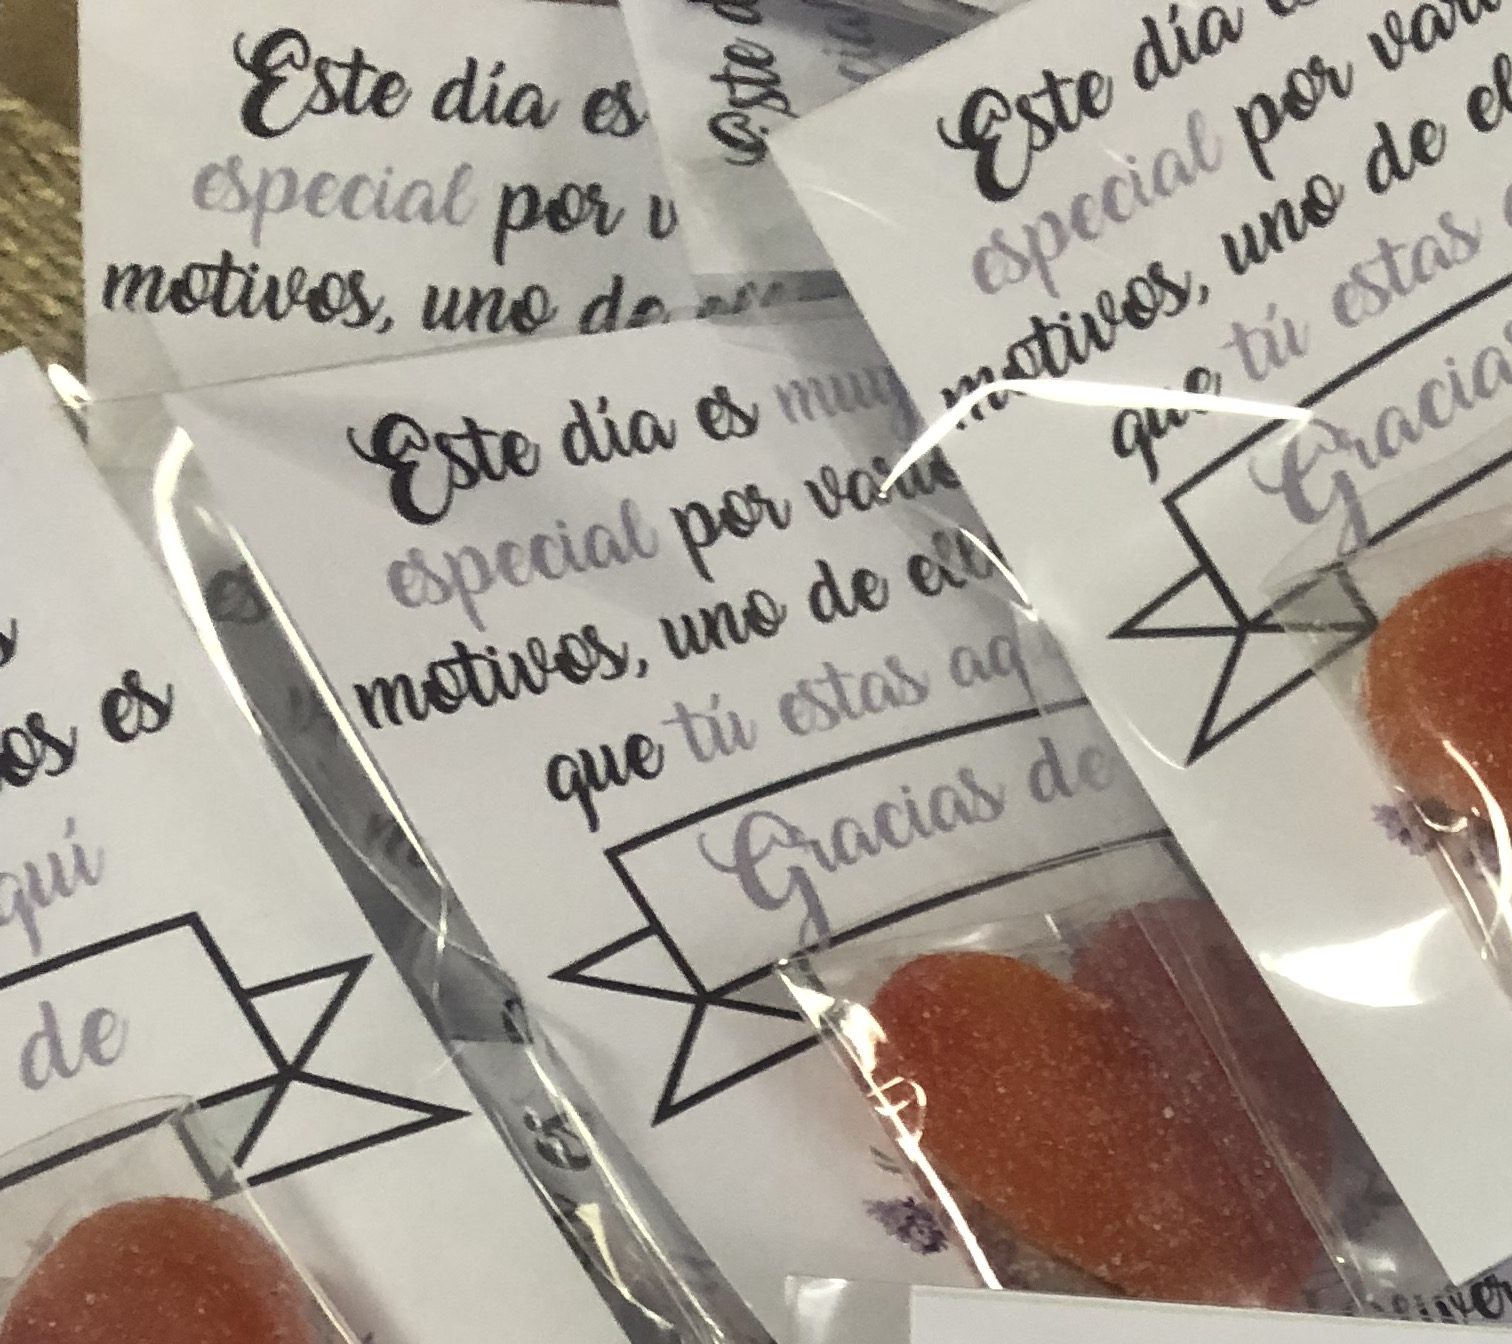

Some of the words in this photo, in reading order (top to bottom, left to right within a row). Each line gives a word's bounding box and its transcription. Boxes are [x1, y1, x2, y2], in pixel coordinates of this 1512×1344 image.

[234, 28, 411, 139] Este
[432, 58, 558, 130] día
[583, 80, 650, 138] es
[938, 68, 1114, 203] Este
[1132, 5, 1245, 93] día
[191, 160, 478, 250] especial
[493, 173, 624, 264] por
[972, 108, 1226, 300] especial
[1235, 50, 1355, 180] por
[1220, 174, 1346, 277] uno
[1366, 116, 1448, 196] de
[101, 250, 393, 333] motivos,
[420, 279, 557, 337] uno
[1109, 366, 1222, 482] que
[1226, 308, 1308, 384] tú
[1332, 212, 1485, 330] estas
[347, 412, 541, 525] Este
[560, 398, 677, 468] día
[697, 386, 760, 440] es
[385, 502, 658, 632] especial
[671, 488, 792, 580] por
[101, 670, 174, 743] es
[354, 612, 649, 730] motivos,
[659, 587, 786, 660] uno
[808, 558, 890, 624] de
[545, 733, 665, 830] que
[672, 693, 758, 764] tú
[778, 654, 930, 736] estas
[0, 817, 104, 958] quí
[697, 765, 1006, 945] Gracias
[20, 1000, 129, 1090] de
